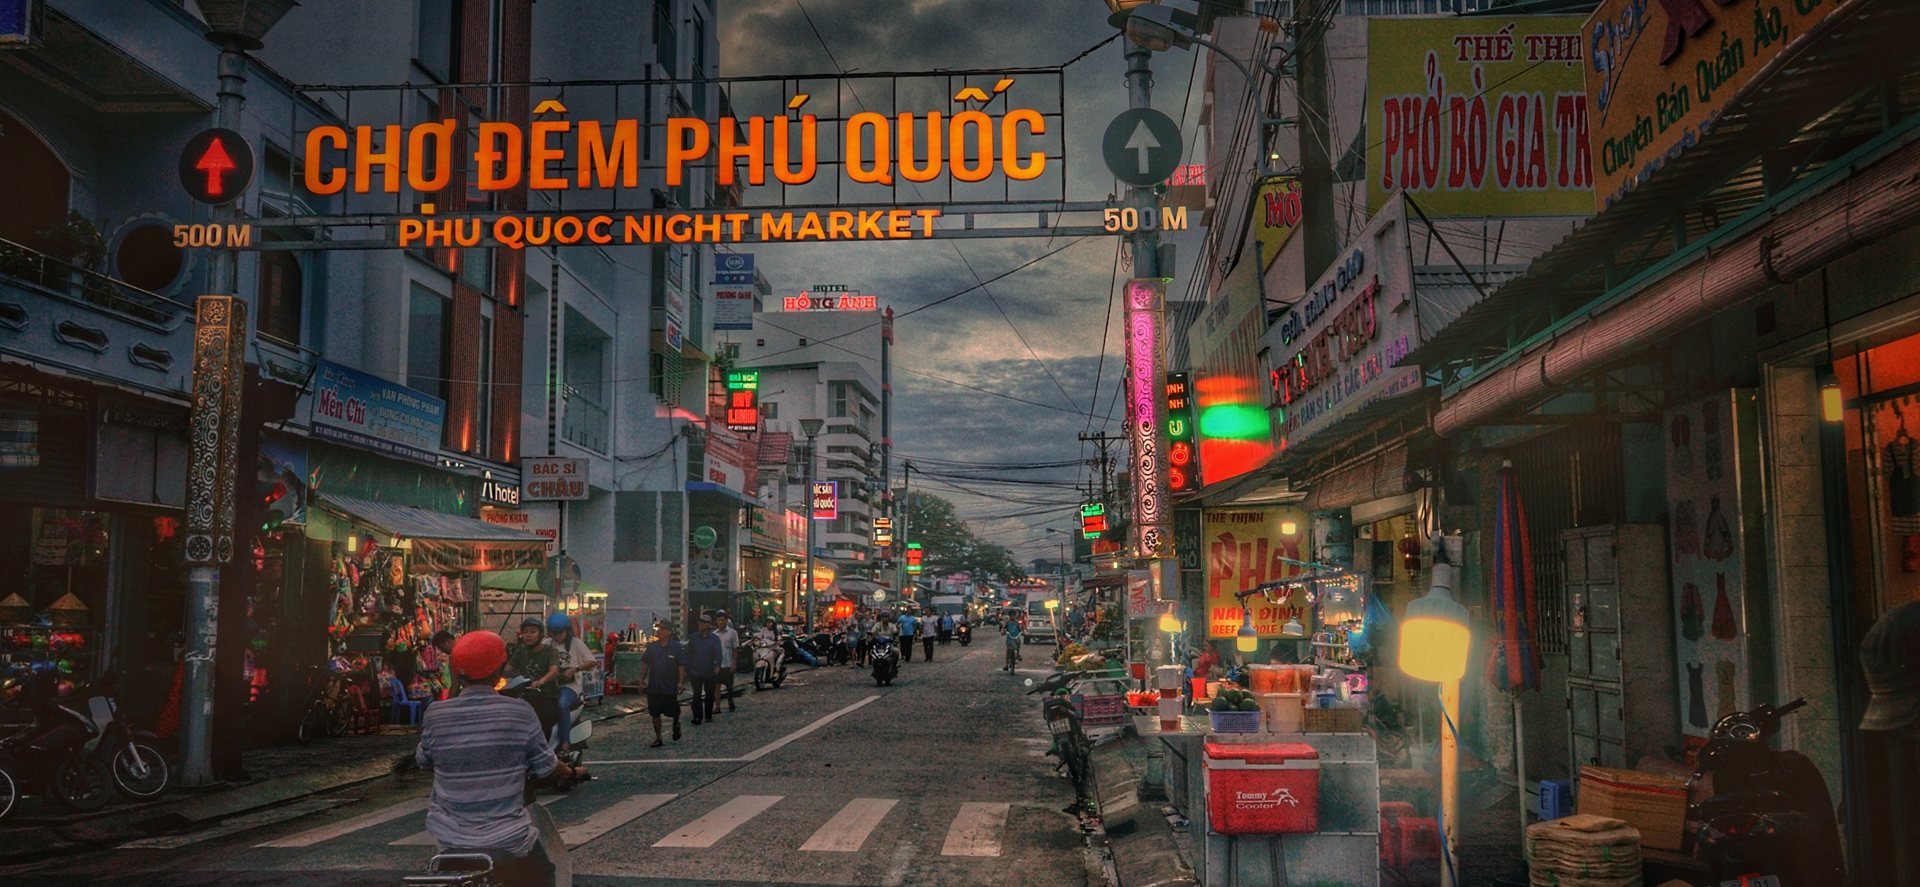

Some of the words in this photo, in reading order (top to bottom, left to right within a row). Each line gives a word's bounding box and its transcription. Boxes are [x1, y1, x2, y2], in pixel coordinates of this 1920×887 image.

[1454, 24, 1515, 61] THẾ
[1602, 115, 1653, 177] Chuyên
[1656, 82, 1690, 134] Bán
[1696, 31, 1745, 103] Quần
[1383, 53, 1442, 189] PHỞ
[1448, 67, 1487, 189] BÒ
[1496, 95, 1547, 188] GIA
[305, 118, 457, 215] CHỢ
[474, 99, 638, 192] ĐÊM
[666, 94, 817, 186] PHÚ
[846, 79, 1046, 186] QUỐC
[399, 217, 482, 248] PHU
[493, 215, 615, 250] QUOC
[624, 213, 749, 244] NIGHT
[761, 209, 942, 242] MARKET
[1104, 206, 1157, 232] 500
[1162, 206, 1188, 231] M
[173, 223, 223, 248] 500
[226, 223, 252, 248] M
[813, 284, 849, 293] HOTEL
[532, 461, 559, 475] BÁC
[495, 483, 520, 505] hotel
[527, 478, 585, 498] CHÂU
[486, 512, 509, 524] PHÒNG
[509, 512, 529, 523] KHÁM
[1212, 624, 1236, 635] BEEF
[1235, 790, 1268, 801] Tommy
[1235, 802, 1276, 810] Cooler
